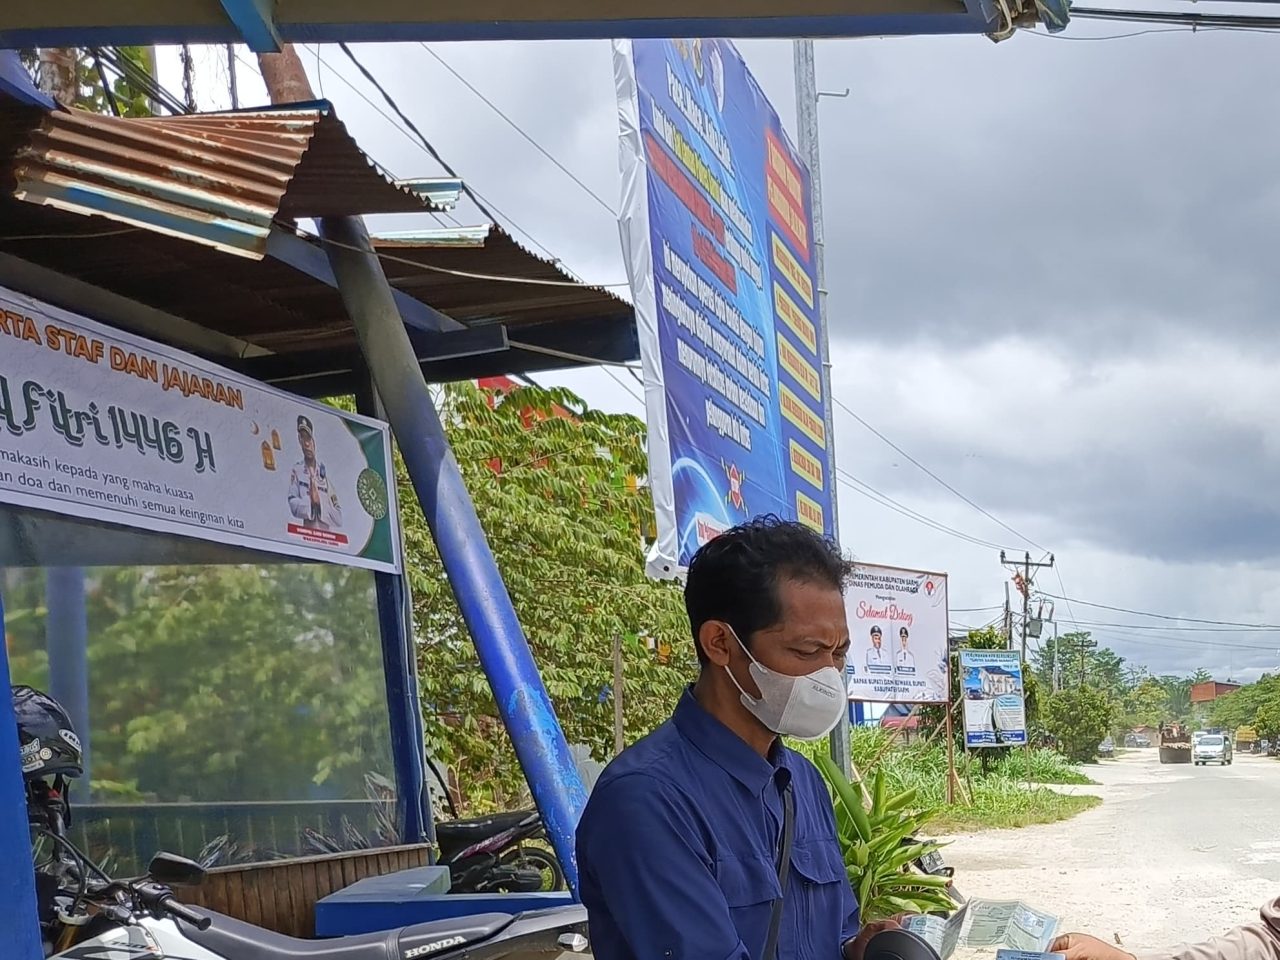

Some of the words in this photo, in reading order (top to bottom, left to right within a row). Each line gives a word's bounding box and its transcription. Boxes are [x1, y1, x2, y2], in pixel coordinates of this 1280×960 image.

[45, 324, 104, 364] STAF
[110, 345, 158, 382] DAN
[162, 363, 244, 410] JAJARAN
[22, 379, 109, 447] Fitri
[107, 405, 185, 464] 1446
[187, 427, 216, 473] H
[18, 472, 43, 489] doa
[48, 478, 72, 494] dan
[76, 486, 138, 507] memenuhi
[142, 500, 176, 515] semua
[180, 504, 225, 525] keinginan
[227, 515, 245, 529] kita
[55, 458, 98, 480] kepada
[102, 473, 130, 490] yang
[132, 479, 162, 494] maha
[164, 483, 194, 501] kuasa
[856, 600, 887, 619] Selamat
[889, 604, 913, 628] Datang
[404, 935, 467, 958] HONDA
